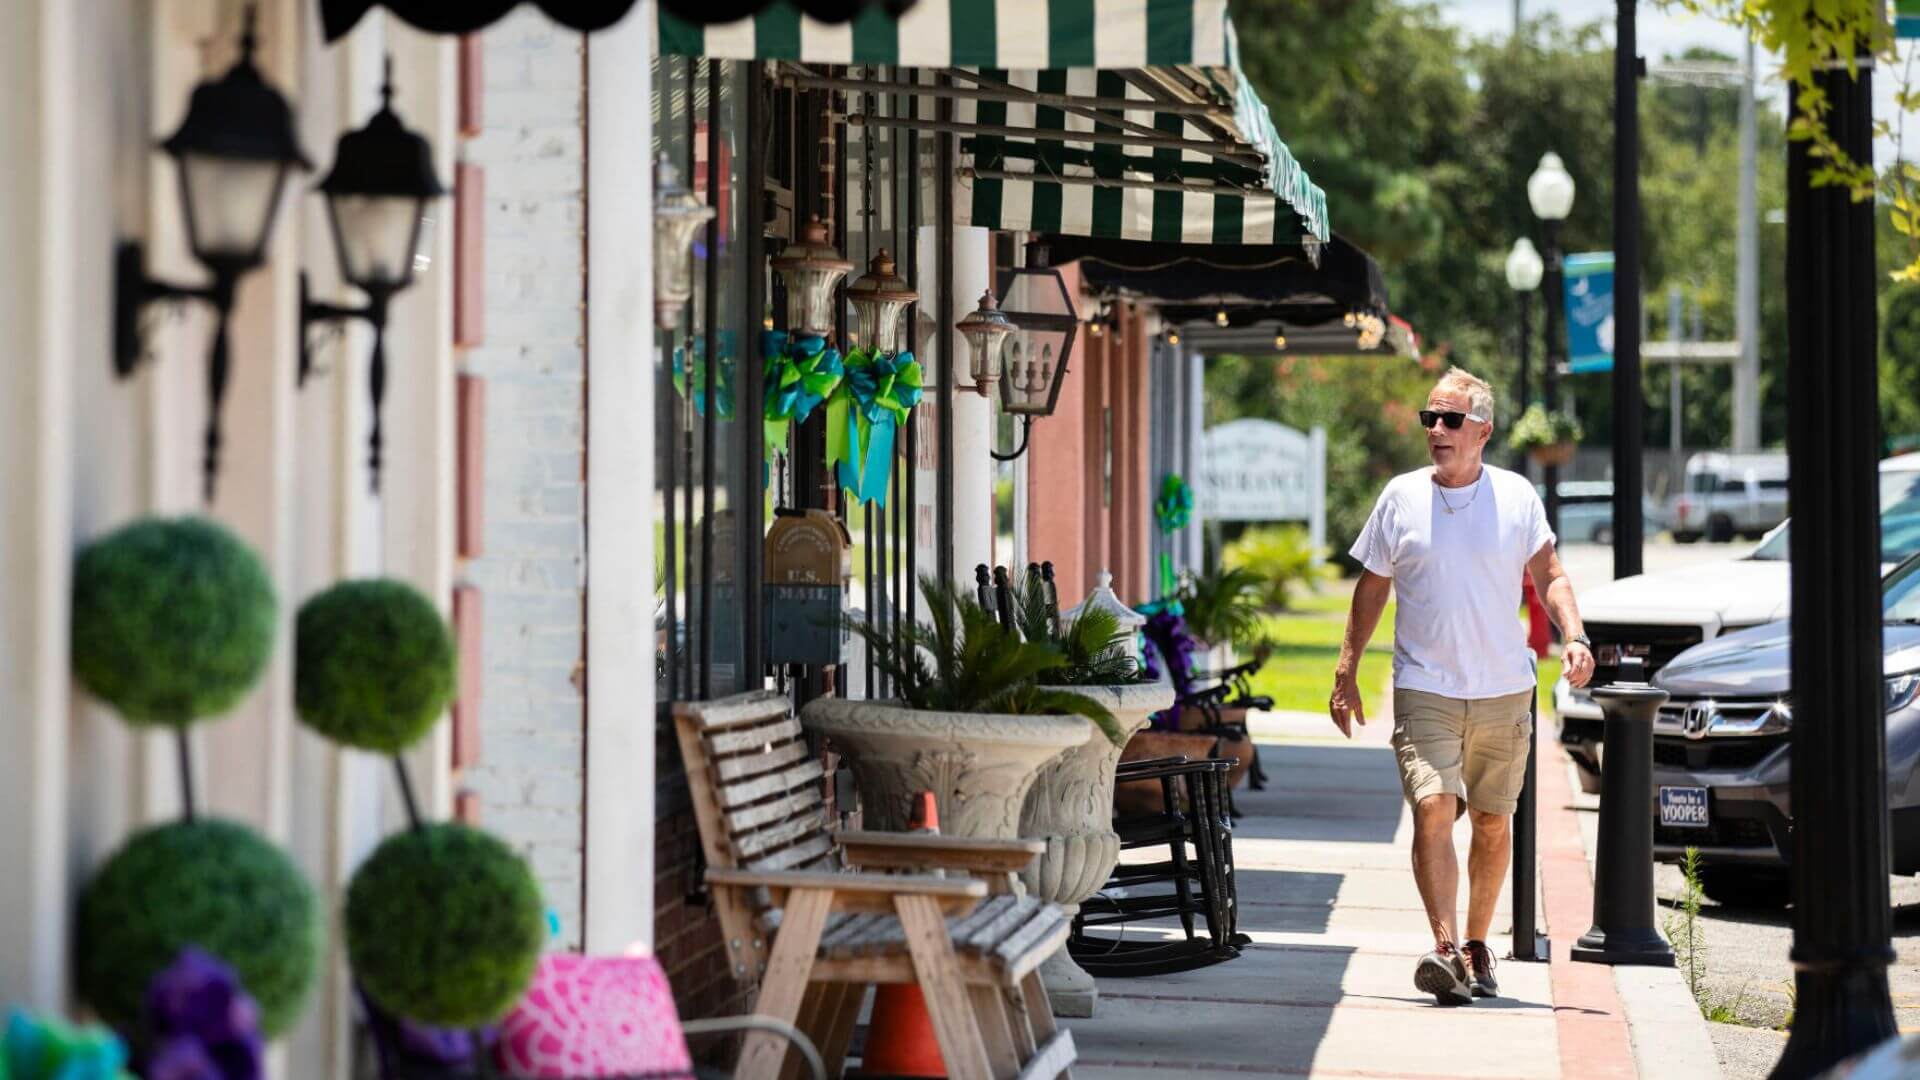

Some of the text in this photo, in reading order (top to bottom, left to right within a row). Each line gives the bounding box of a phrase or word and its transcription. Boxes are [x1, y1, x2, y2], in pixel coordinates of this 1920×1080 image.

[787, 570, 820, 582] U.S.
[779, 587, 827, 601] MAIL
[1664, 805, 1705, 821] YOOPER
